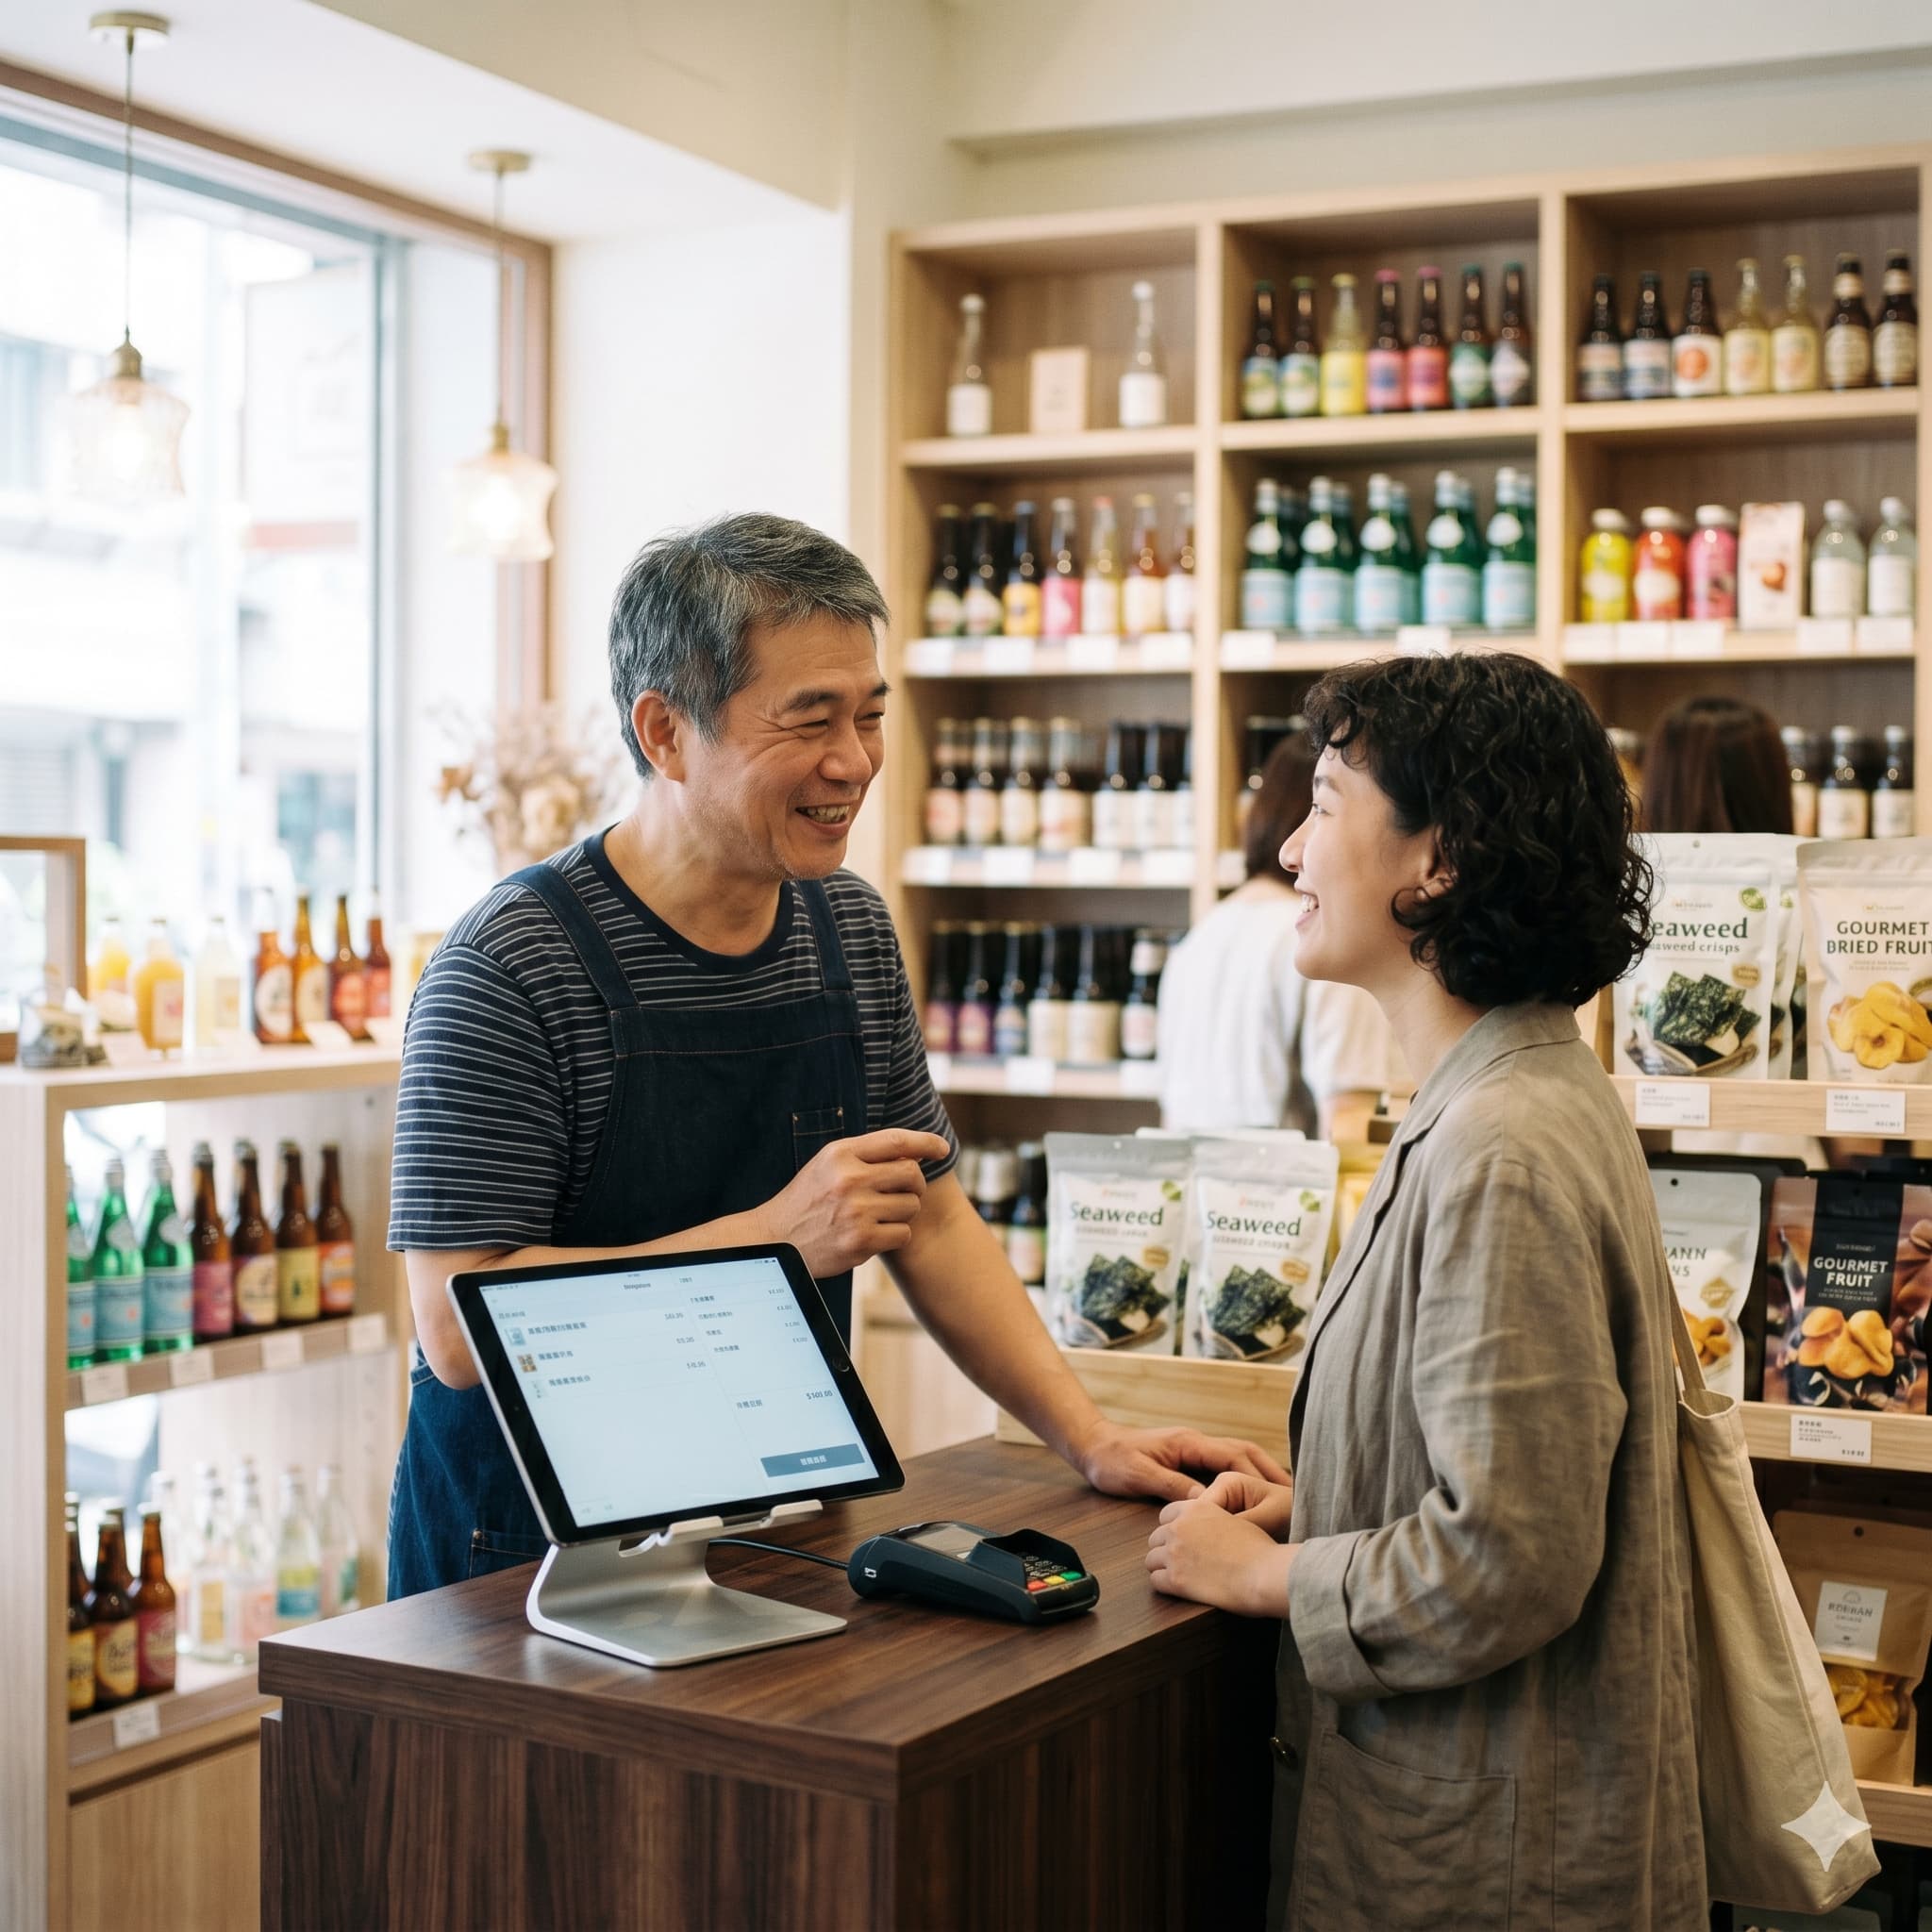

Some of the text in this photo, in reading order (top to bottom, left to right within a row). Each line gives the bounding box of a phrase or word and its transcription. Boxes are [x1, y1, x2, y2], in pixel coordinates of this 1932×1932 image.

[1651, 917, 1748, 939] eaweed
[1836, 921, 1930, 935] GOURMET
[1698, 941, 1740, 956] crisps
[1070, 1201, 1165, 1226] Seaweed
[1207, 1211, 1303, 1238] Seaweed
[1664, 1246, 1707, 1260] ANN
[1813, 1257, 1889, 1274] GOURMET
[1825, 1272, 1874, 1288] FRUIT
